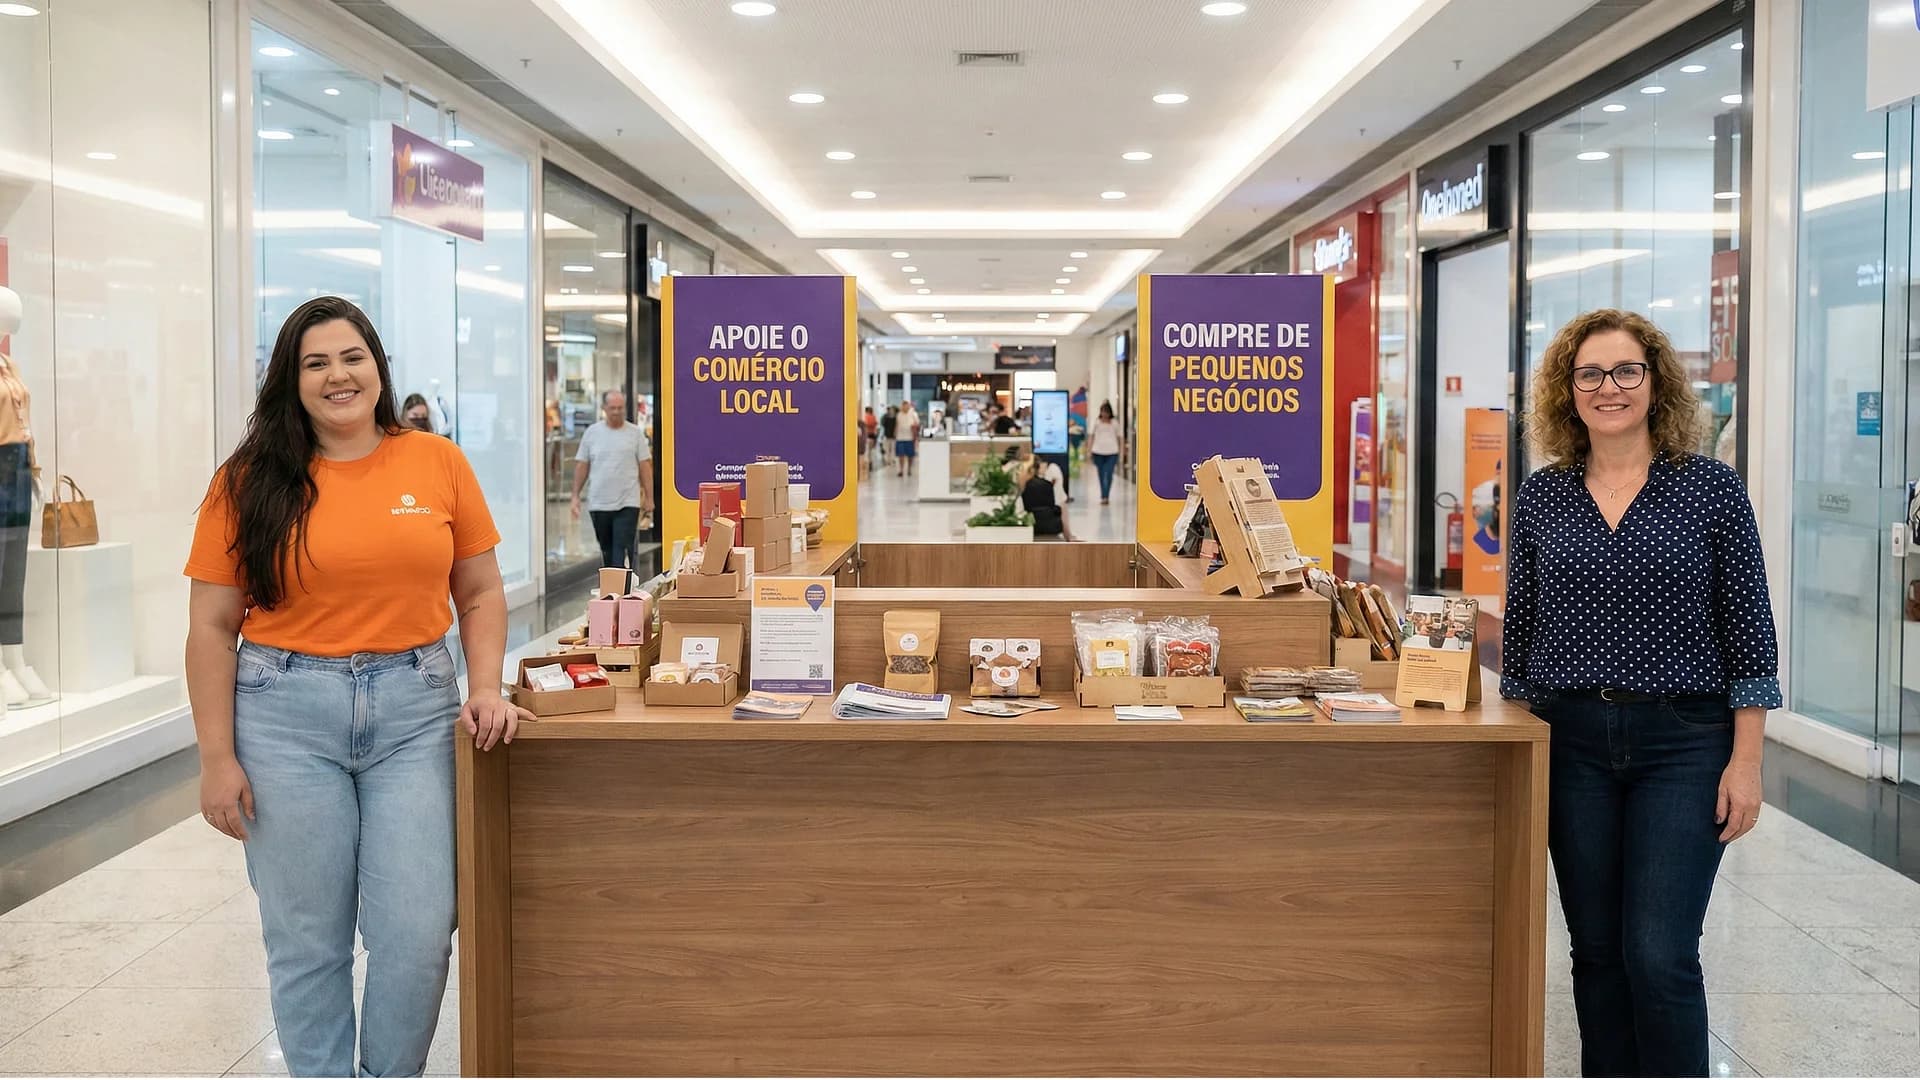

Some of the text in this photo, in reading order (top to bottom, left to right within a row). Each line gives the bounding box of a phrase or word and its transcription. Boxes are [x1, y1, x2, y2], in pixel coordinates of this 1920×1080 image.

[709, 324, 809, 350] APOIE O
[1163, 322, 1310, 348] COMPRE DE
[693, 351, 825, 382] COMÉRCIO
[1170, 355, 1304, 383] PEQUENOS
[720, 389, 799, 414] LOCAL
[1173, 382, 1300, 413] NEGÓCIOS
